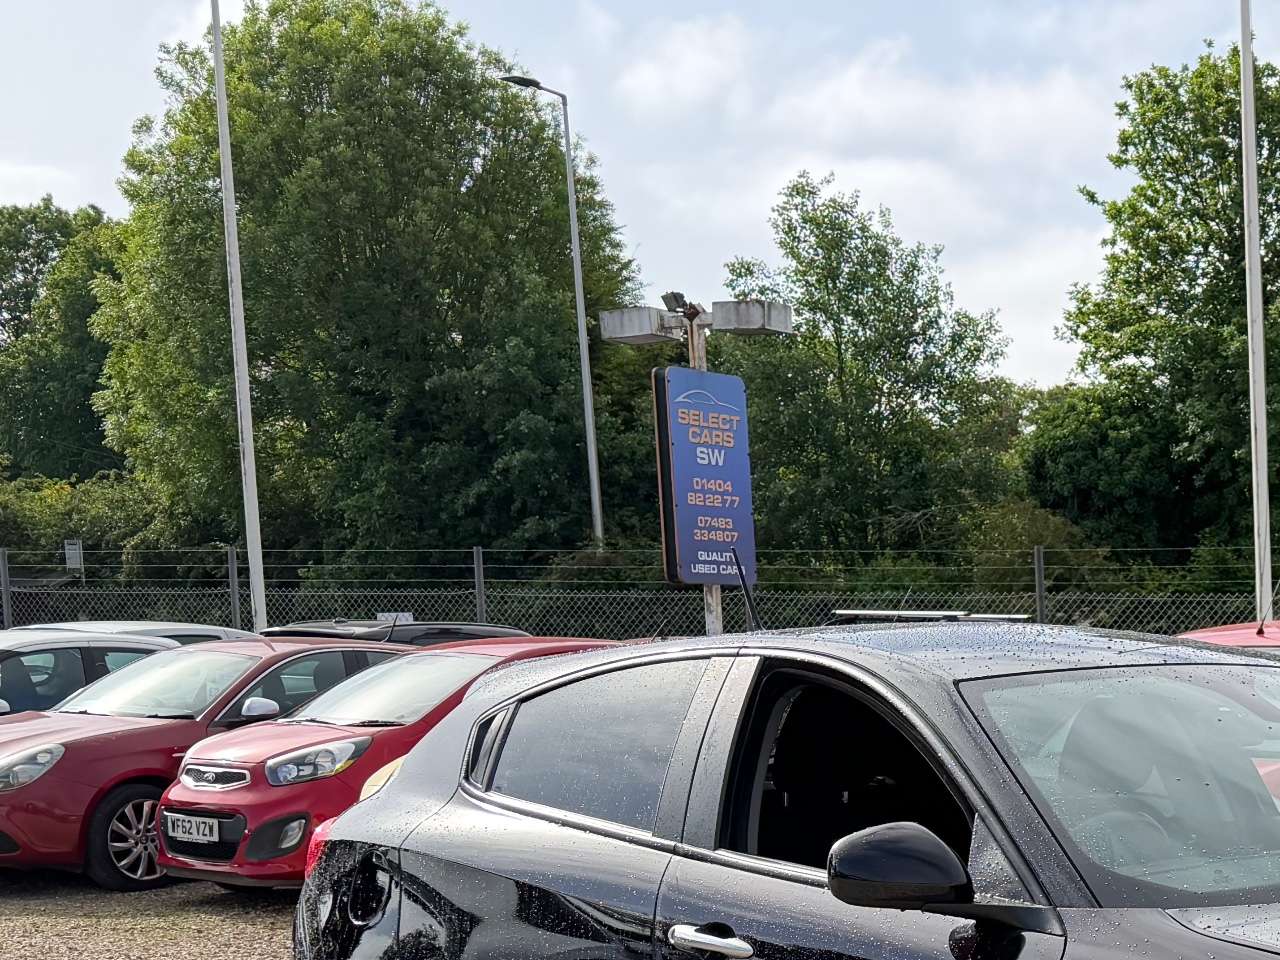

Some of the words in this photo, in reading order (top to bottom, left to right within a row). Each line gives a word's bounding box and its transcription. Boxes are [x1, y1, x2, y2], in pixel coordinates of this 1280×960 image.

[678, 409, 740, 431] SELECT
[688, 427, 734, 448] CARS
[696, 447, 725, 467] SW
[693, 477, 733, 493] 01404
[691, 563, 718, 574] USED
[171, 816, 193, 836] WF62
[195, 819, 214, 838] VZW
